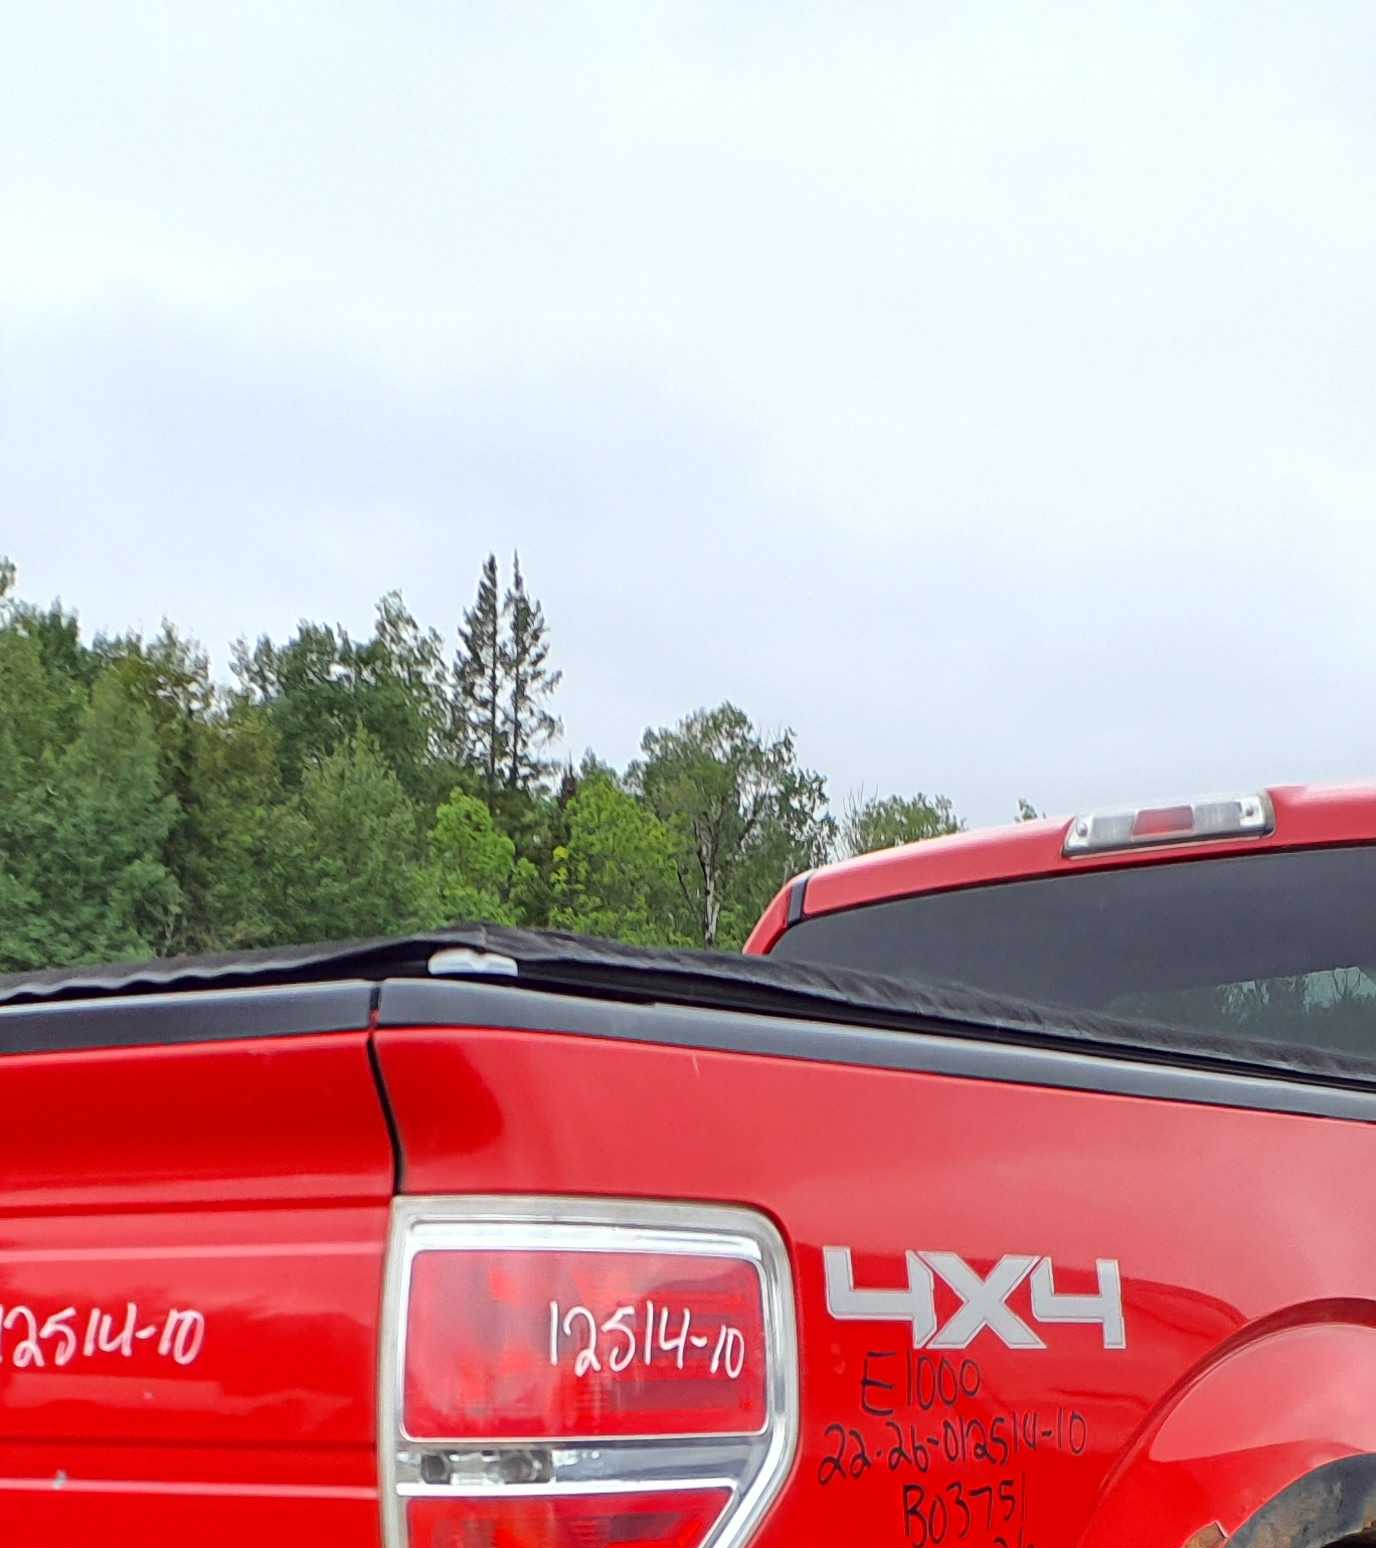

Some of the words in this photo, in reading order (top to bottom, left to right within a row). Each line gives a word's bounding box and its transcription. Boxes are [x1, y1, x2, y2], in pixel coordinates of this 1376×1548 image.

[823, 1246, 1126, 1349] 4X4
[549, 1300, 745, 1379] 12514-10
[861, 1348, 982, 1417] E1000
